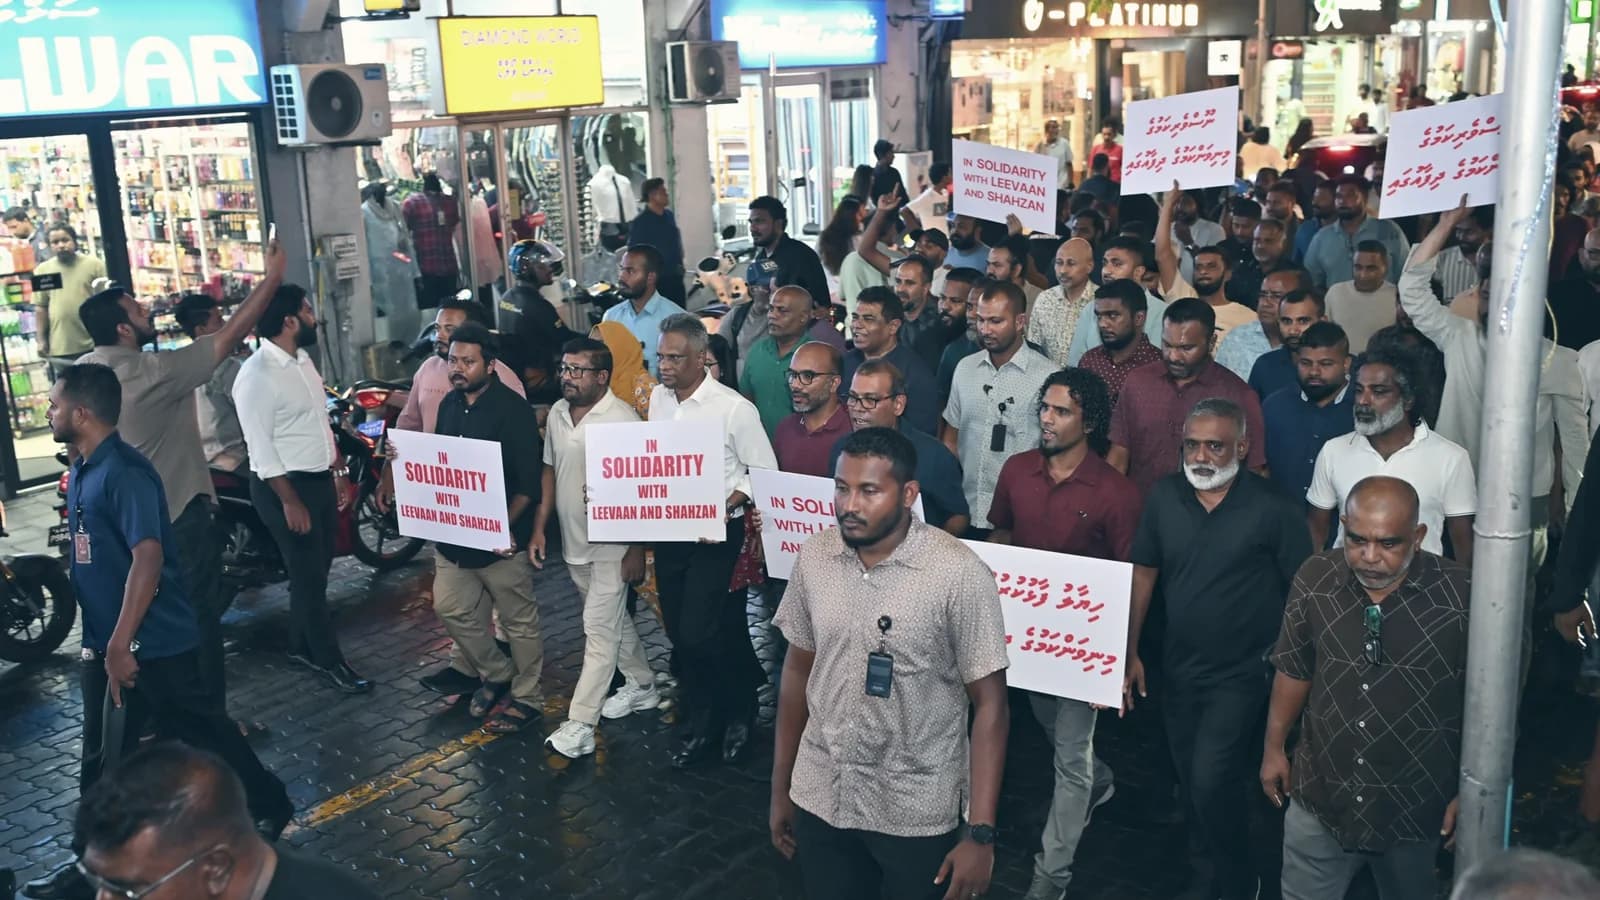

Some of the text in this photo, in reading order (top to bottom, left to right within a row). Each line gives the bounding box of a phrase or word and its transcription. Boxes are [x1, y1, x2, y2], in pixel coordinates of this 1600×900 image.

[460, 28, 530, 47] DIAMOND
[963, 158, 1046, 181] IN SOLIDARITY
[963, 173, 1045, 197] WITH LEEVAAN
[964, 188, 1045, 212] AND SHAHZAN
[646, 439, 657, 453] IN
[438, 451, 448, 465] IN
[602, 454, 704, 479] SOLIDARITY
[405, 462, 487, 493] SOLIDARITY
[435, 492, 460, 508] WITH
[637, 484, 668, 498] WITH
[592, 504, 717, 520] LEEVAAN AND SHAHZAN
[770, 496, 835, 517] IN SOLI
[401, 505, 502, 533] LEEVAAN AND SHAHZAN
[774, 518, 814, 535] WITH
[781, 541, 800, 553] AN
